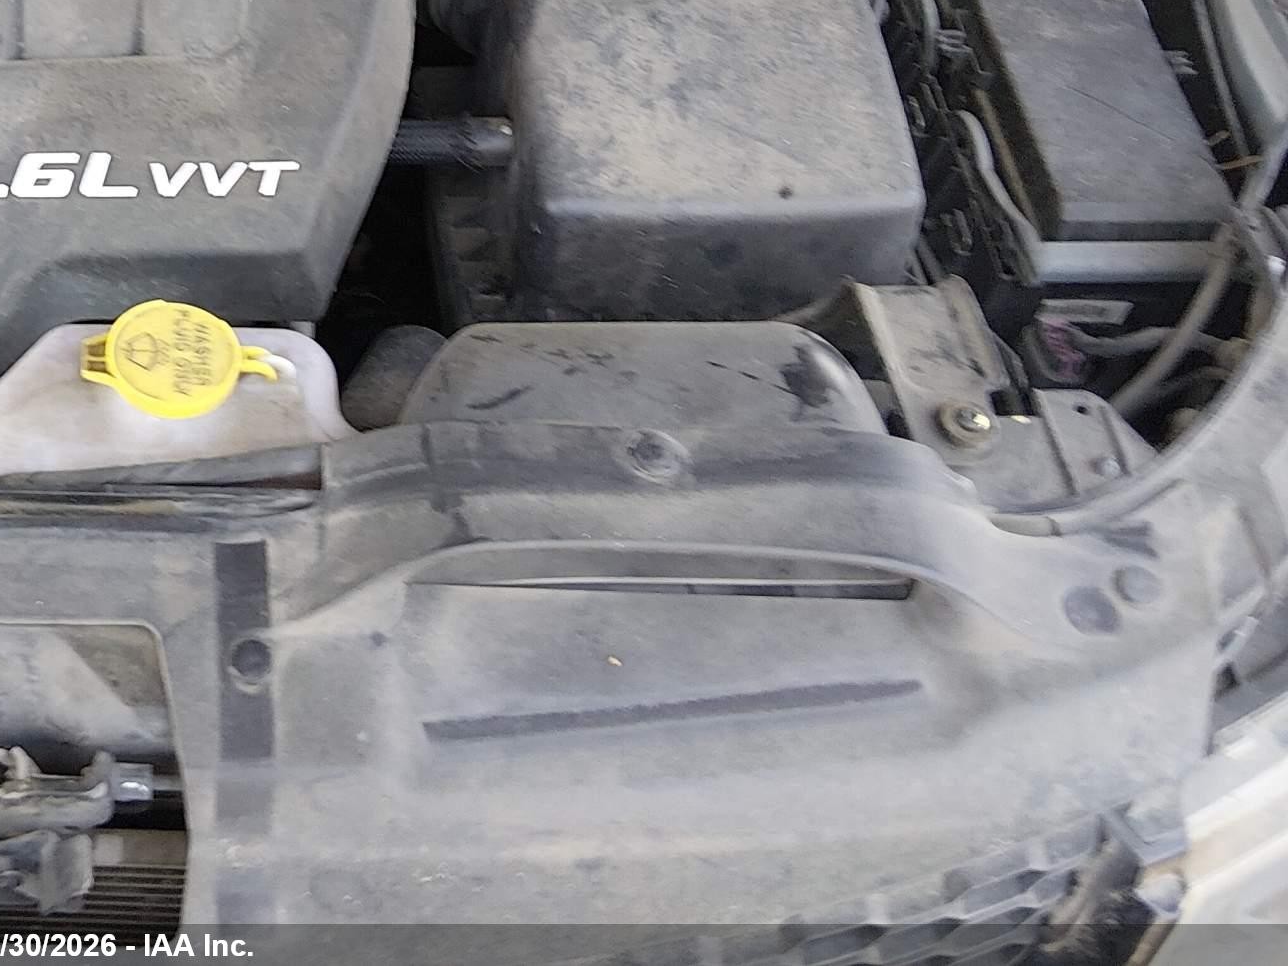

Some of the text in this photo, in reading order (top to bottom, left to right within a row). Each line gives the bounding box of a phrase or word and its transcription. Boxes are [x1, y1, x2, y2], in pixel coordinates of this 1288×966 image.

[149, 160, 300, 197] VVT
[174, 308, 192, 396] FLUID ONLY
[192, 322, 212, 386] WASHER
